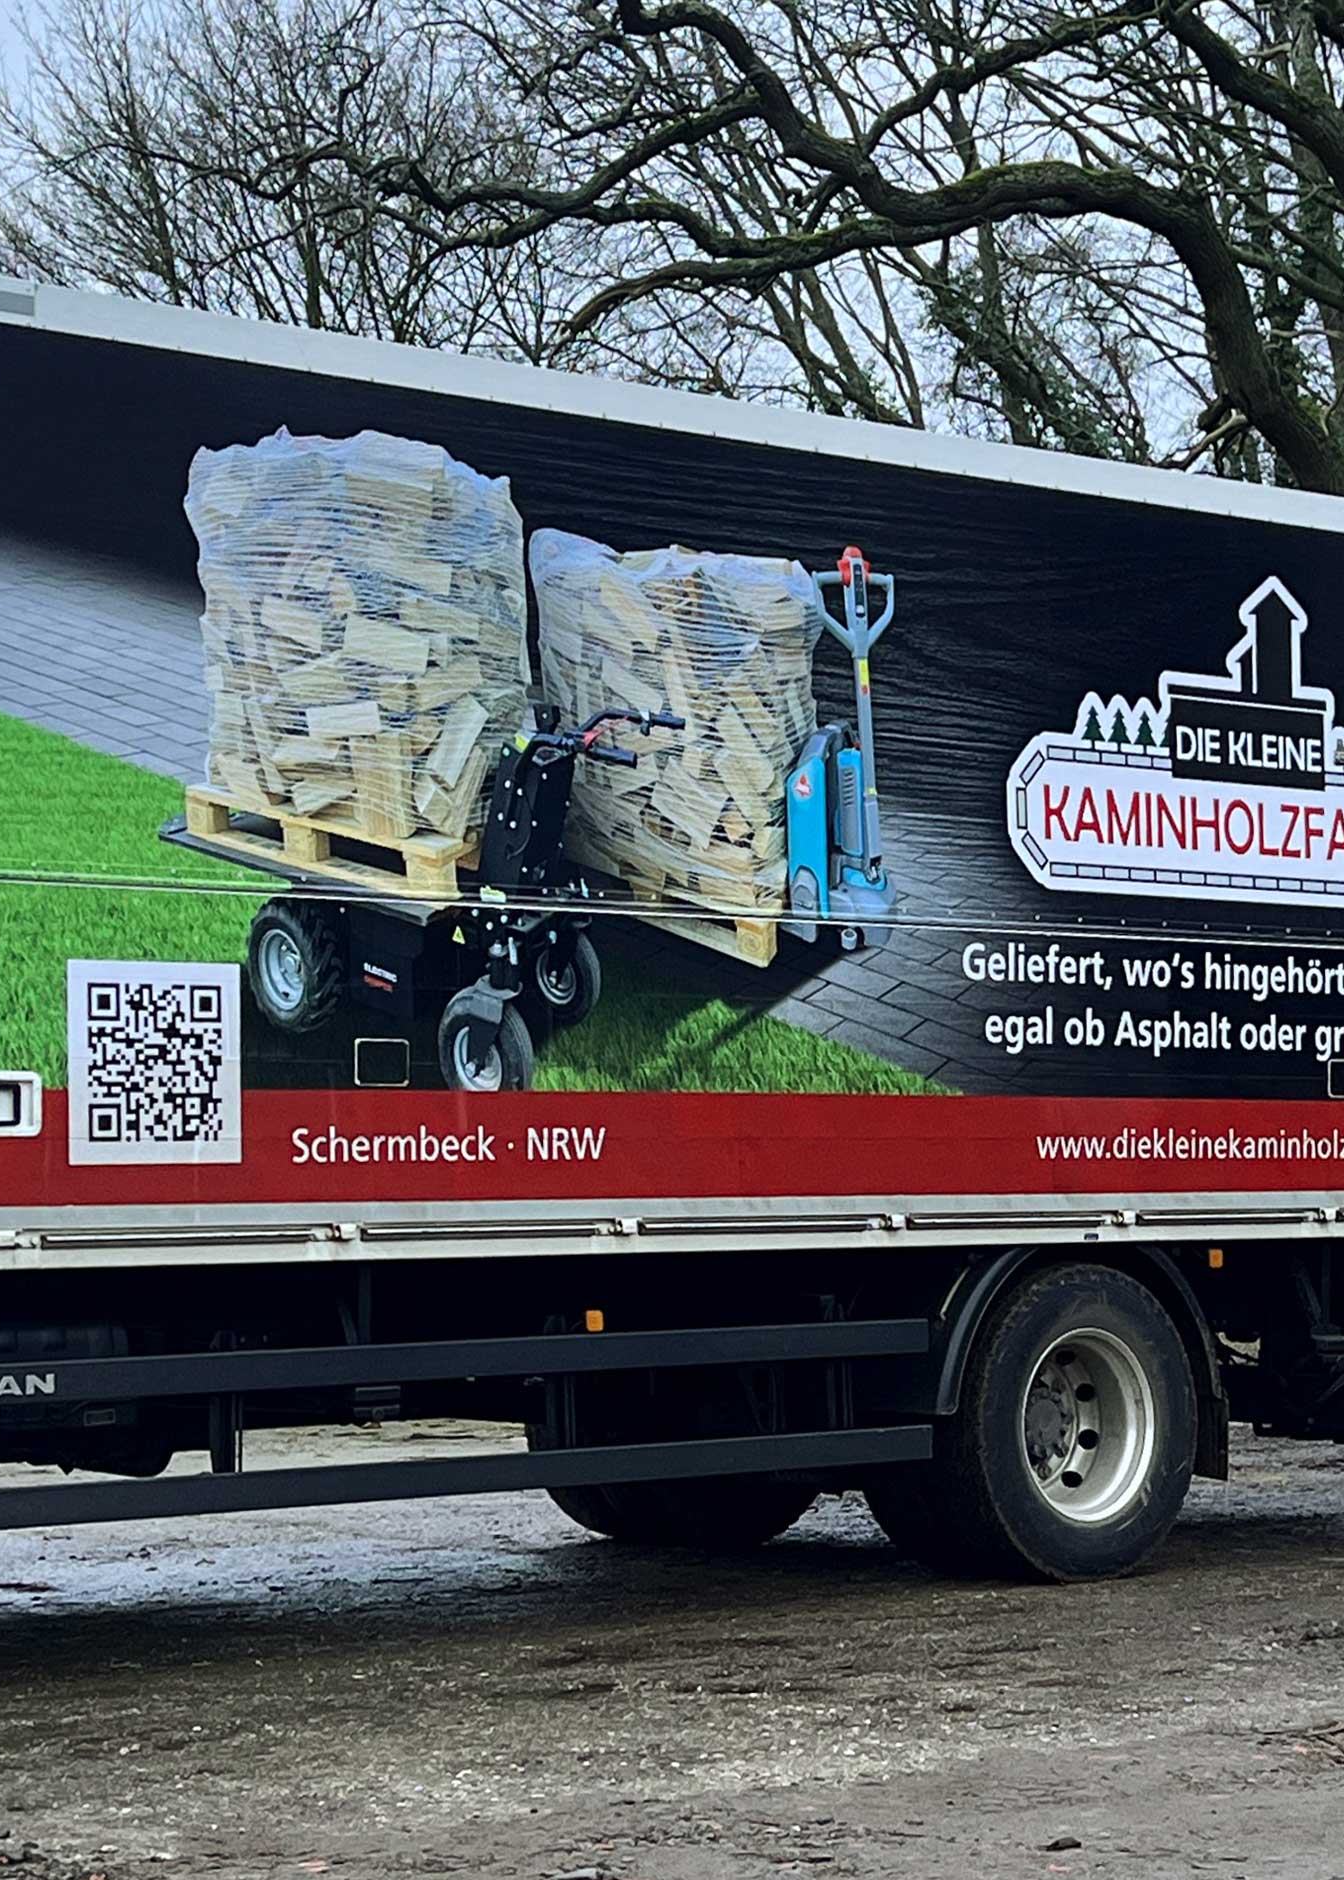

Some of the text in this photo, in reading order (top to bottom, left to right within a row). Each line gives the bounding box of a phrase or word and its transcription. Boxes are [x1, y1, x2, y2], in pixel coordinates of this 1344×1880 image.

[1175, 725, 1323, 774] DIE KLEINE
[962, 942, 1114, 990] Geliefert,
[985, 1006, 1053, 1055] egal
[1064, 1007, 1105, 1046] ob
[1114, 1010, 1231, 1057] Asphalt
[1240, 1017, 1306, 1051] oder
[292, 1126, 496, 1163] Schermbeck
[526, 1127, 606, 1161] NRW
